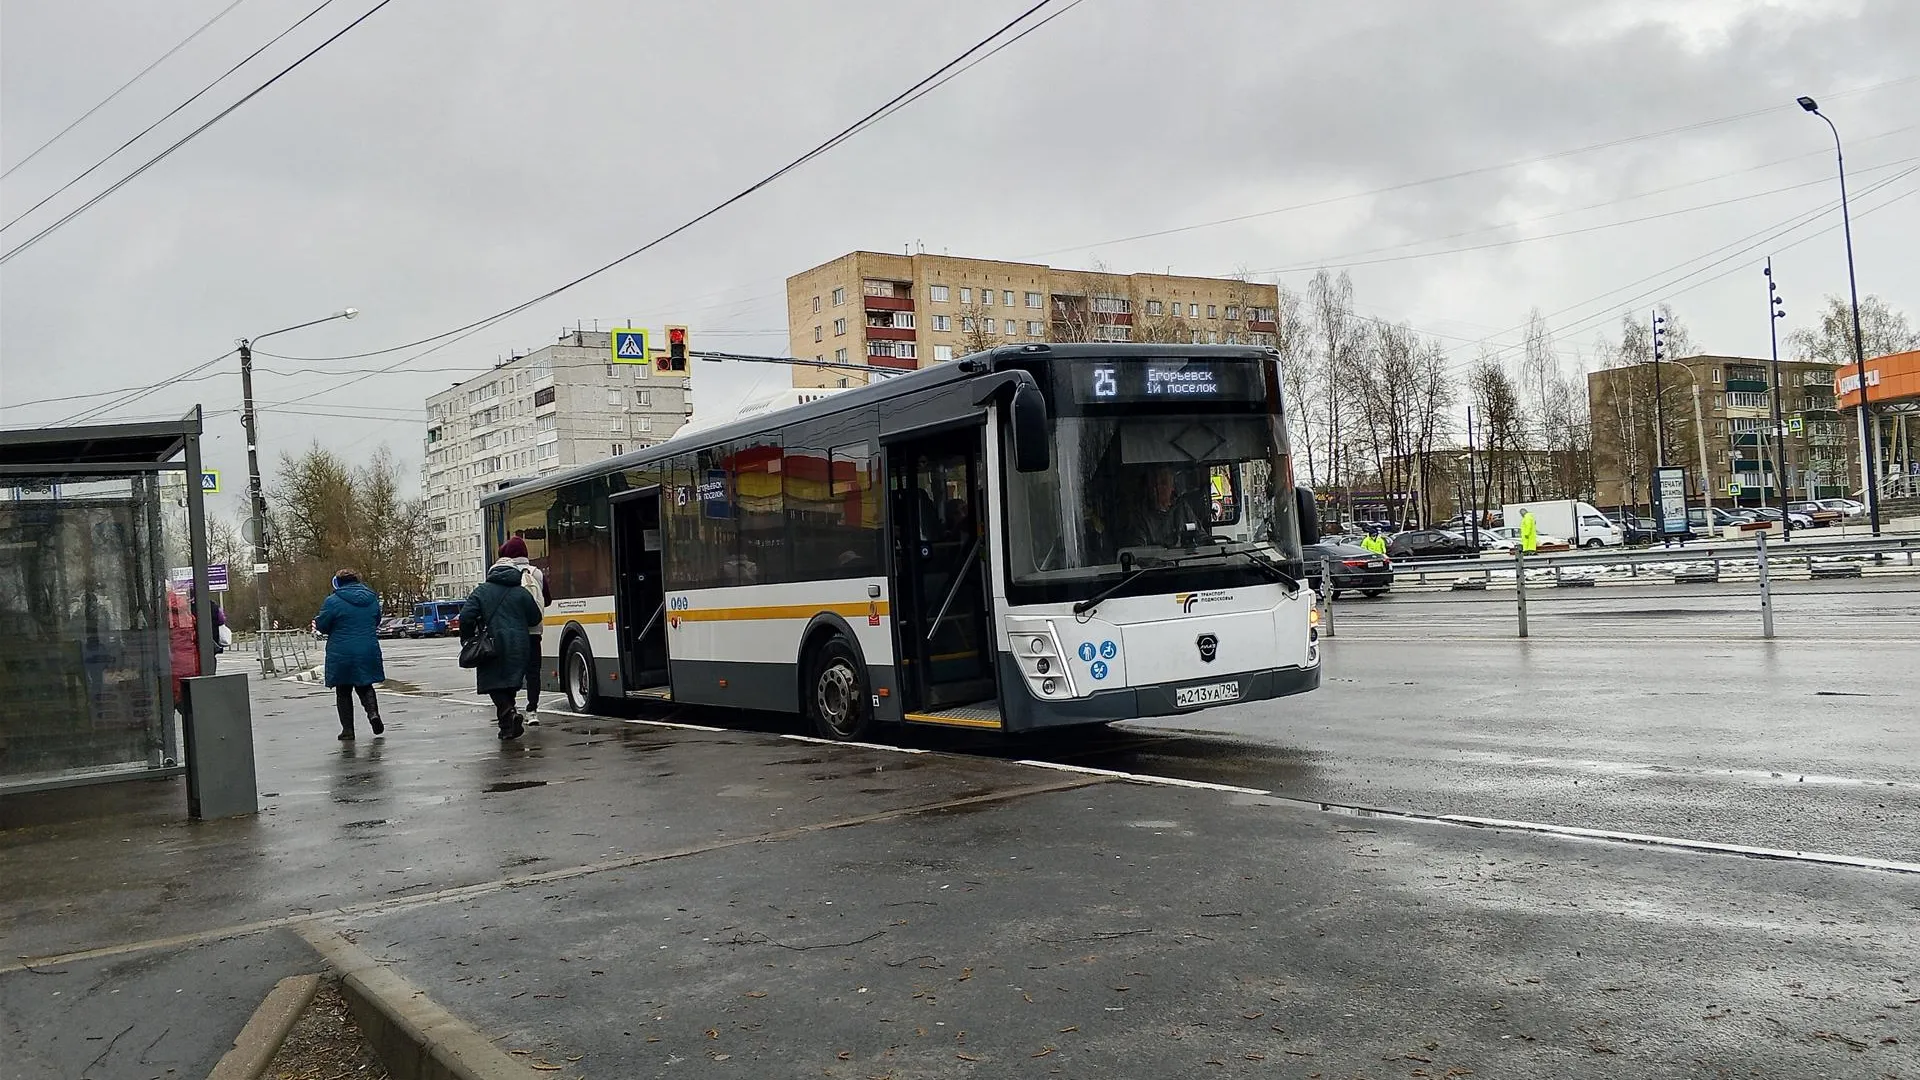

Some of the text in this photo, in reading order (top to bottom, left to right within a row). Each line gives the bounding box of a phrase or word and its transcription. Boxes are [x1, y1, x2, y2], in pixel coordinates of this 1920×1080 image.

[1094, 369, 1117, 396] 25
[1148, 369, 1212, 382] Егорьевск
[1167, 383, 1217, 394] поселок
[677, 486, 686, 506] 25
